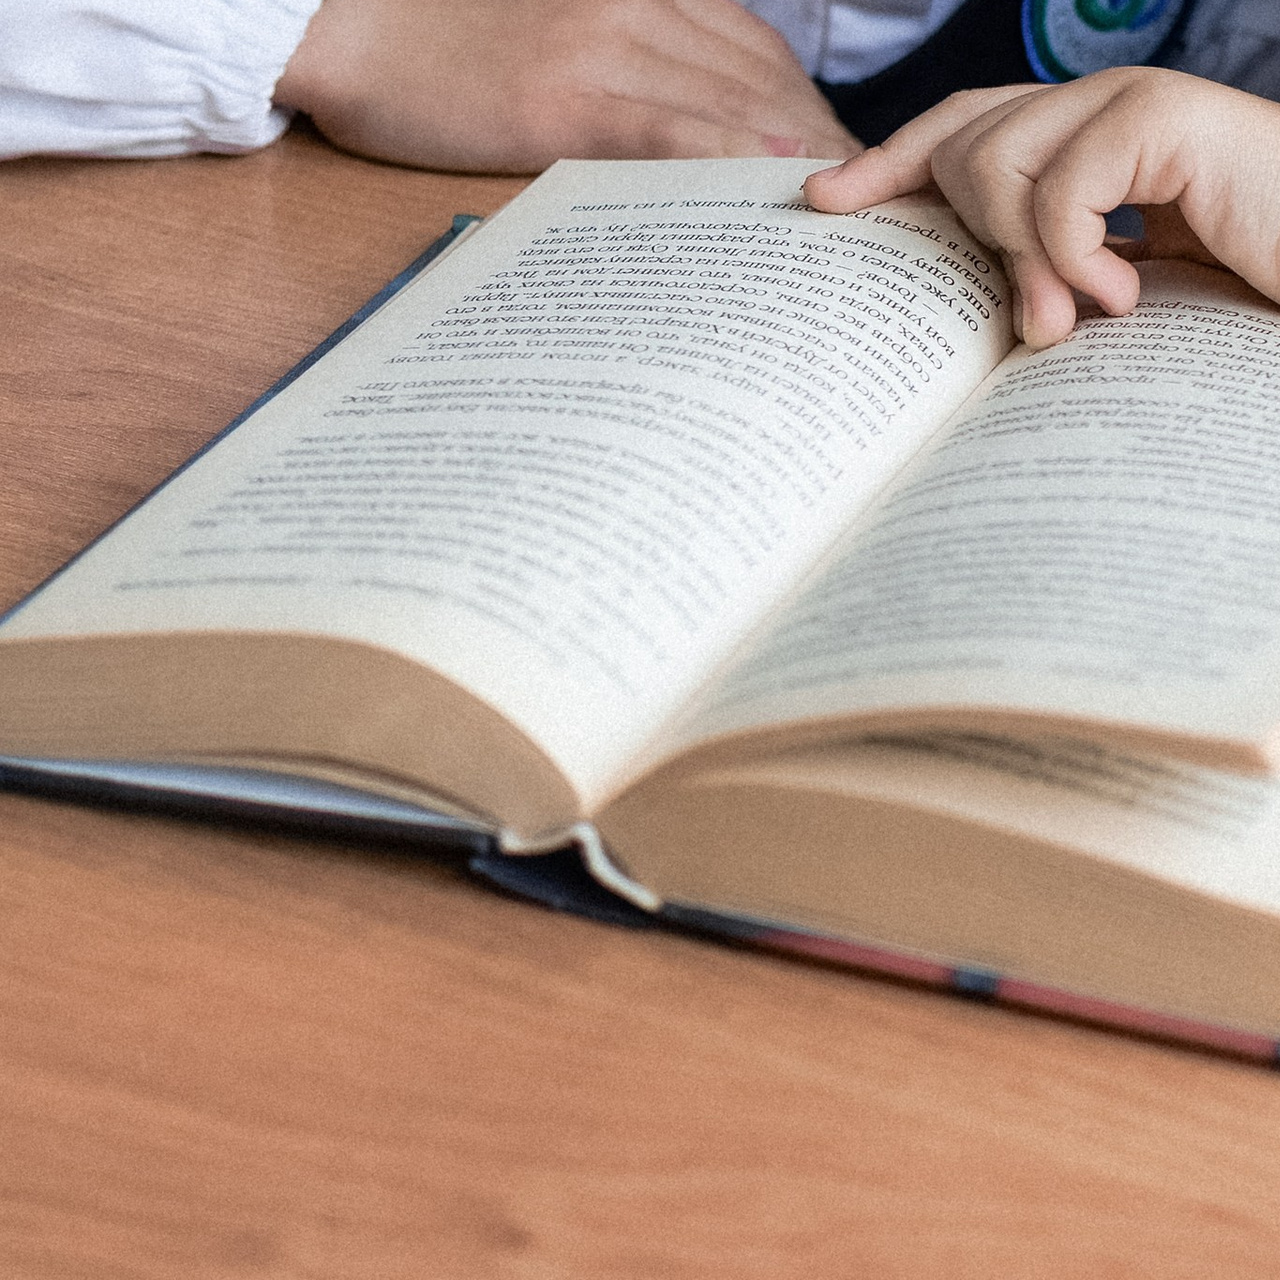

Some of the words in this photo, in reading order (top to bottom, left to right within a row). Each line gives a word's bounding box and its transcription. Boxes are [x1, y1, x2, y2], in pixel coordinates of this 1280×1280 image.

[569, 202, 630, 212] ящика
[632, 202, 656, 210] из
[680, 200, 755, 209] крышку,
[566, 226, 597, 234] что
[602, 224, 630, 234] Ну
[630, 222, 792, 236] Сосредоточился?
[872, 214, 942, 243] третий
[530, 234, 599, 246] сделать
[602, 232, 655, 242] Гарри
[658, 232, 756, 244] разрешил
[758, 238, 790, 247] что
[562, 246, 594, 254] его
[598, 246, 623, 254] по
[625, 244, 669, 254] Судя
[676, 244, 747, 257] Люпин.
[798, 240, 837, 254] том,
[946, 240, 959, 252] в
[604, 254, 692, 265] середину
[748, 248, 830, 267] спросил
[842, 250, 856, 258] о
[518, 256, 600, 267] кабинета.
[696, 258, 718, 266] на
[722, 260, 785, 272] вышел
[962, 250, 990, 274] Он
[544, 268, 568, 277] на
[572, 266, 612, 276] дом
[612, 268, 694, 278] покинет
[858, 254, 919, 282] жалел
[909, 258, 955, 286] одну
[489, 270, 539, 280] Тисо-
[699, 270, 732, 280] что
[740, 272, 802, 290] понял,
[789, 267, 845, 286] снова
[934, 254, 1003, 308] начали!
[474, 280, 511, 290] чув-
[516, 280, 574, 288] своих
[580, 279, 604, 287] на
[610, 279, 767, 296] сосредоточился
[847, 282, 862, 292] и
[856, 270, 918, 304] Готов?
[462, 292, 518, 302] Гарри,
[590, 291, 702, 303] счастливых
[807, 286, 833, 298] он
[920, 282, 957, 308] уже
[496, 303, 547, 312] тогда
[704, 296, 756, 310] было
[776, 292, 829, 313] силы,
[868, 288, 926, 327] улице,
[957, 286, 990, 320] еще
[444, 306, 477, 316] его
[554, 302, 714, 317] воспоминанием,
[758, 304, 784, 316] не
[838, 295, 892, 324] когда
[1180, 304, 1239, 318] слезы
[482, 315, 545, 324] нельзя
[546, 315, 581, 323] это
[581, 316, 628, 326] Если
[833, 310, 867, 330] все
[957, 307, 979, 332] он
[1136, 312, 1172, 320] сам
[430, 318, 480, 328] было
[628, 317, 725, 334] Хогвартс!
[786, 312, 862, 346] вообще
[1170, 324, 1200, 332] же
[1191, 314, 1272, 336] шнурки,
[415, 332, 442, 340] он
[446, 330, 477, 338] что
[500, 328, 611, 337] волшебник
[614, 329, 642, 337] он
[646, 331, 680, 340] что
[718, 311, 837, 353] счастливым
[1082, 331, 1127, 340] лицу
[1131, 332, 1164, 340] его
[1200, 328, 1232, 338] тут
[484, 340, 517, 348] что
[551, 340, 615, 349] нашел
[689, 334, 750, 354] узнал,
[925, 326, 955, 358] вой
[1168, 335, 1195, 343] по
[1198, 338, 1232, 348] что
[1236, 334, 1268, 345] Он
[427, 341, 484, 350] искал,
[618, 343, 649, 354] Он
[740, 330, 828, 366] Дурслей
[898, 322, 942, 370] ствах,
[383, 354, 454, 364] голову
[458, 352, 534, 362] поднял
[541, 352, 609, 362] потом
[656, 346, 742, 369] Люпина.
[751, 350, 778, 364] он
[870, 328, 930, 383] собрав
[1100, 354, 1160, 362] хотел
[743, 364, 768, 378] на
[822, 363, 848, 380] от
[863, 345, 918, 398] жизни
[1004, 354, 1094, 378] выиграть
[1073, 365, 1104, 374] Он
[782, 361, 836, 394] когда
[842, 352, 906, 410] назвать
[1020, 375, 1156, 391] пробормотал
[403, 378, 494, 390] сильного
[707, 372, 768, 397] вдруг
[847, 380, 896, 425] уедет
[774, 396, 832, 440] Гарри
[842, 392, 882, 437] день,
